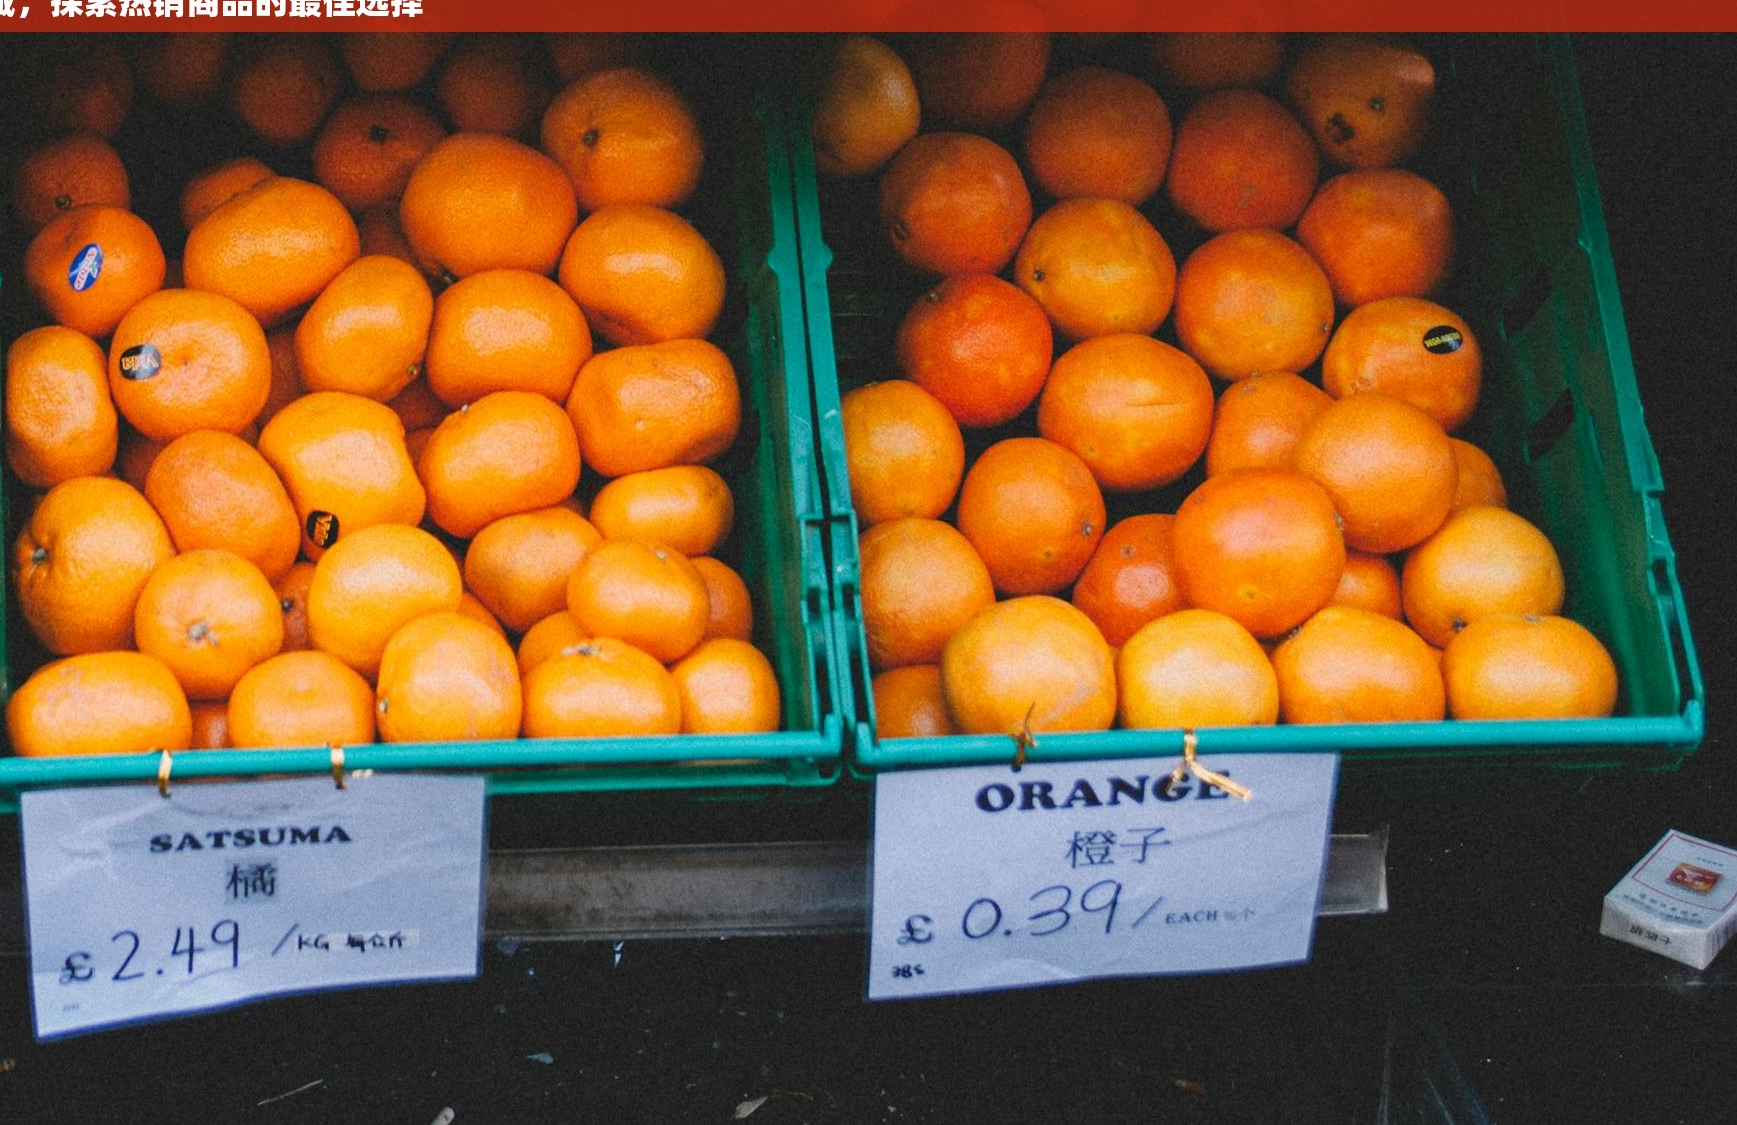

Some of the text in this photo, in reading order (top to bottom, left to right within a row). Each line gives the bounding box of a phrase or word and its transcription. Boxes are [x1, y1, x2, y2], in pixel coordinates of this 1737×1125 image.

[975, 770, 1231, 813] ORANGE
[149, 825, 352, 853] SATSUMA
[1064, 825, 1172, 869] 橙子
